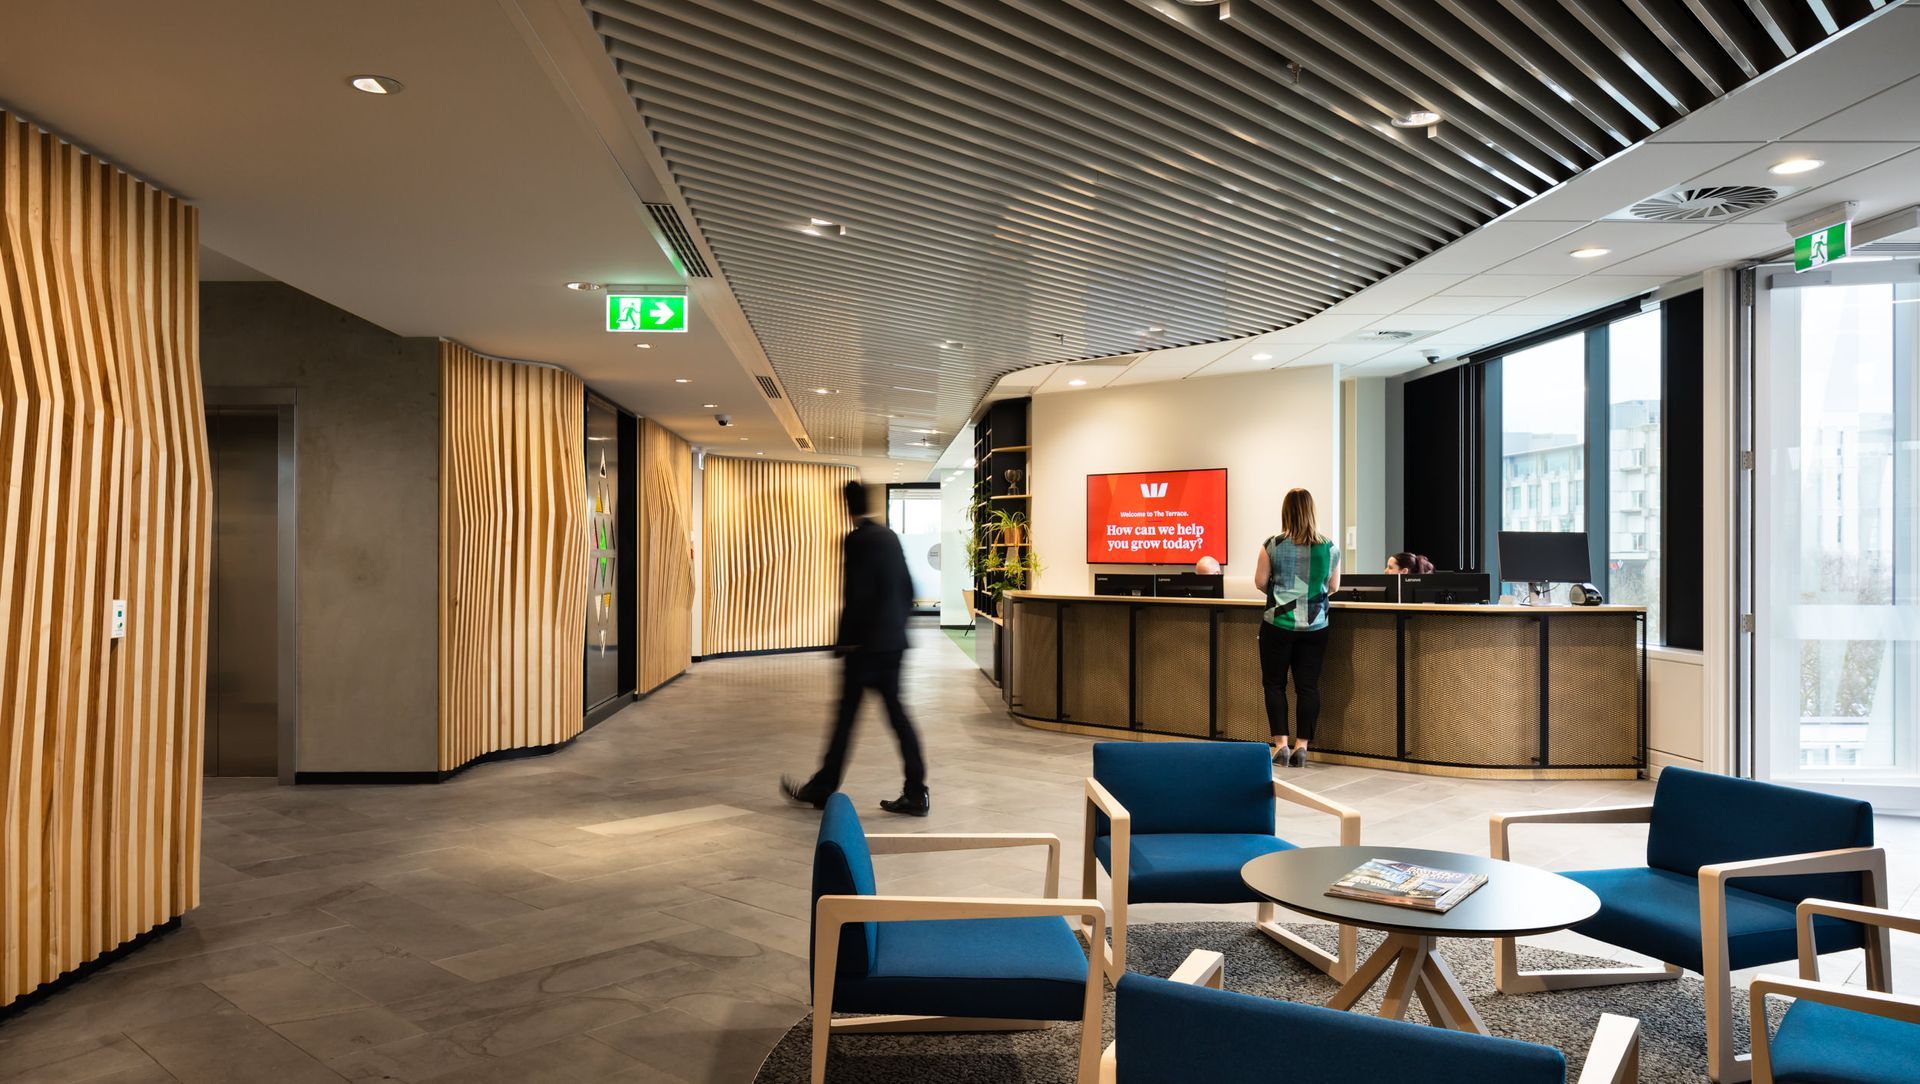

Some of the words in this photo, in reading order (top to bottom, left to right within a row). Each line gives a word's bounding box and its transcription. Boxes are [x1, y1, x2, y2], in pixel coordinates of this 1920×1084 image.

[1106, 524, 1132, 536] How
[1134, 526, 1156, 536] can
[1158, 526, 1175, 535] we
[1177, 523, 1205, 537] help
[1107, 539, 1129, 551] you
[1131, 539, 1161, 551] grow
[1163, 537, 1204, 551] today?
